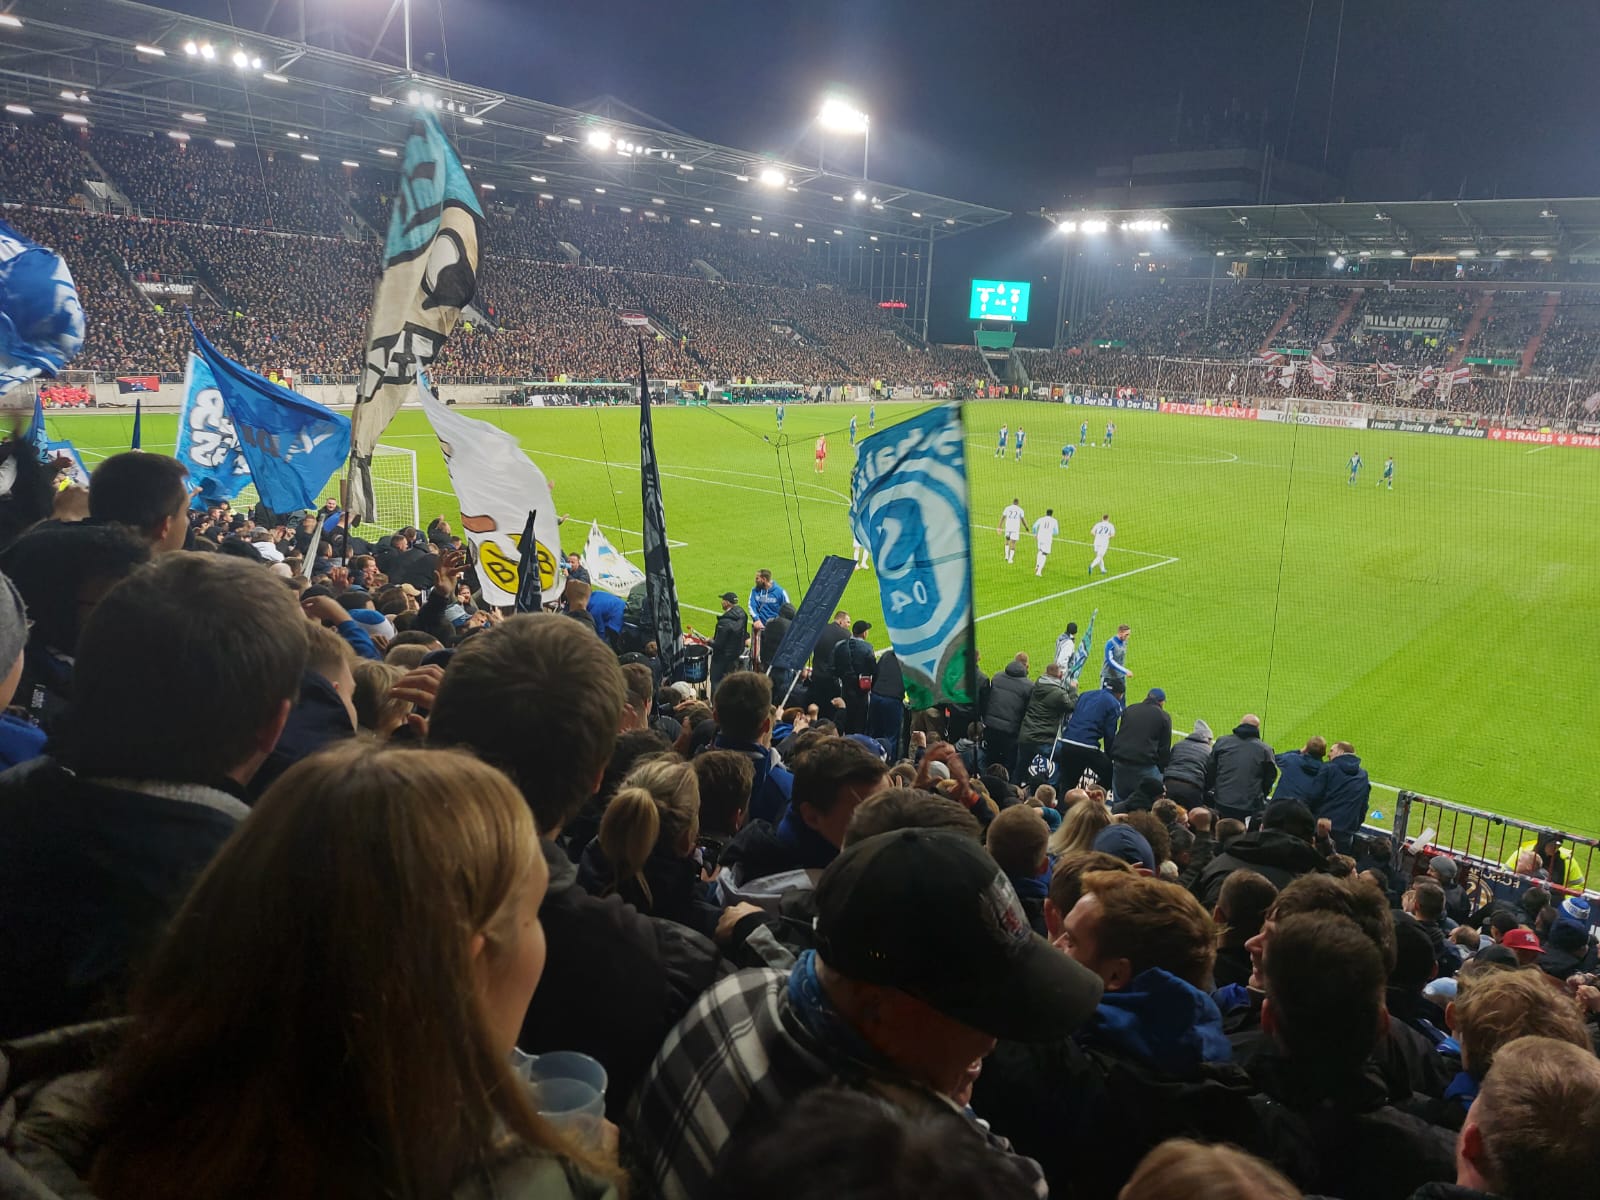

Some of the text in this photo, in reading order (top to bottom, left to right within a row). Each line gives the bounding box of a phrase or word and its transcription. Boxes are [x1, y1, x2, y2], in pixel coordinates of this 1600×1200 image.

[1364, 315, 1449, 328] MILLERNTOR
[1083, 397, 1097, 406] Der
[1126, 400, 1141, 409] Der
[1169, 402, 1246, 418] FLYERALARM
[1399, 421, 1424, 432] bwin
[1428, 422, 1454, 435] bwin
[1457, 426, 1484, 438] bwin
[1505, 431, 1553, 443] STRAUSS
